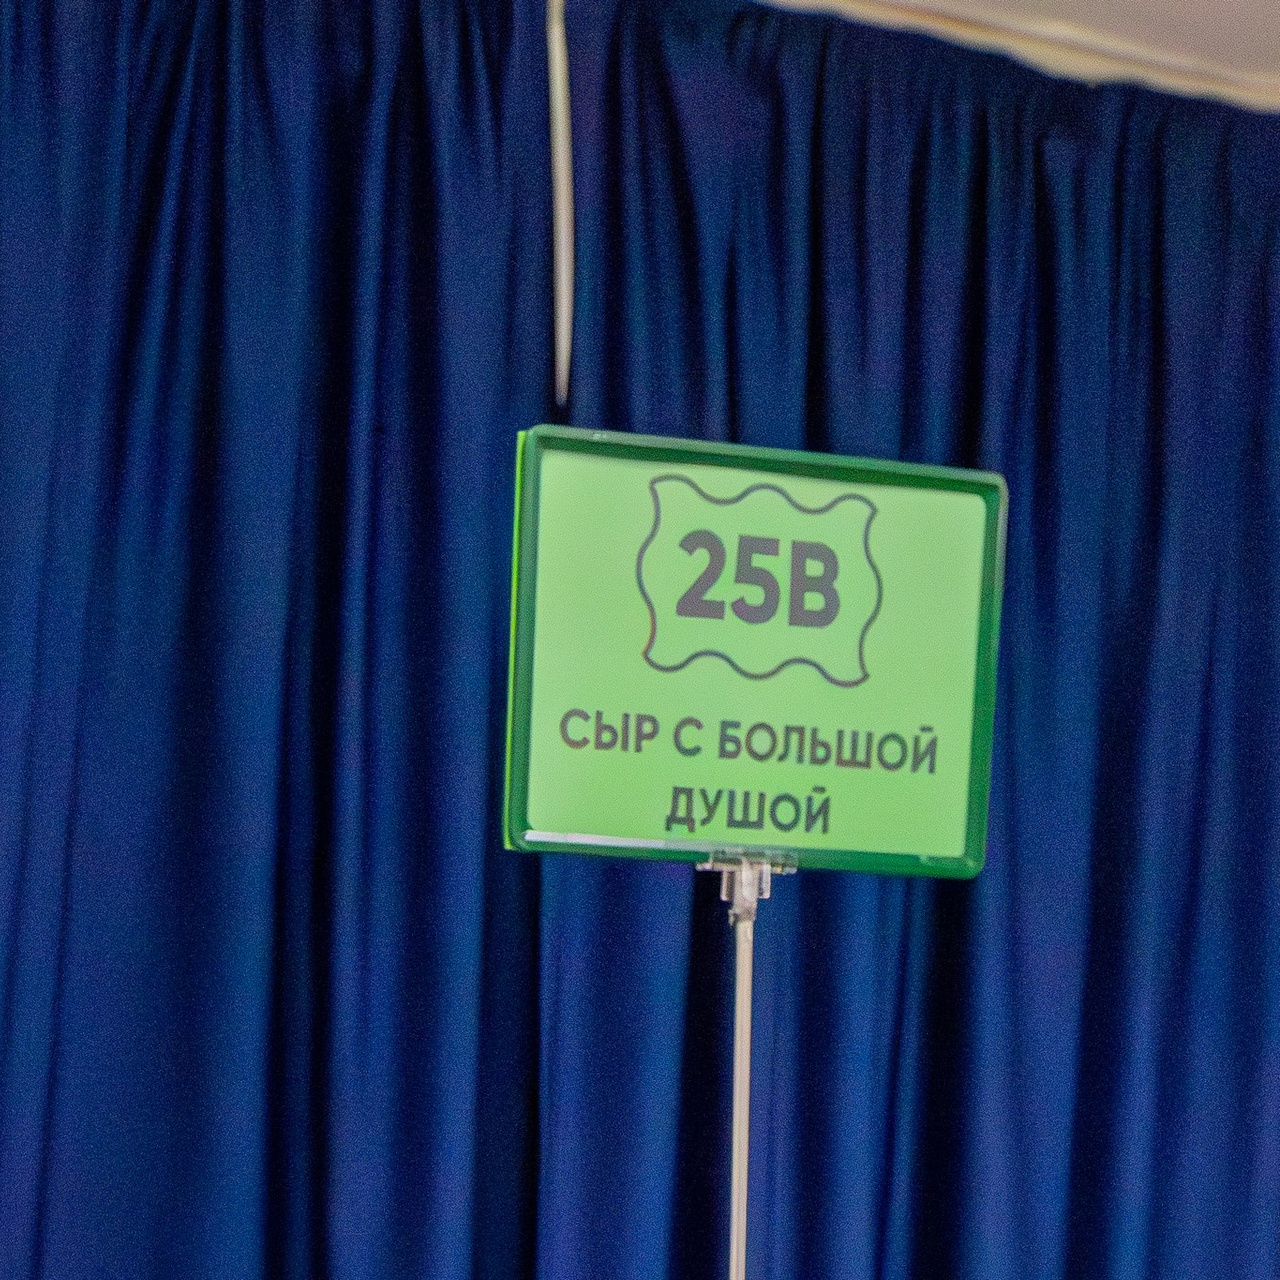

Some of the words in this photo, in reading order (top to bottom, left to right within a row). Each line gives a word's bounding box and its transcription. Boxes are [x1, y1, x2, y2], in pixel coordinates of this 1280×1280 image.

[675, 528, 840, 628] 25В
[559, 708, 659, 753] СЫР
[673, 716, 703, 756] С
[718, 720, 939, 774] БОЛЬШОЙ
[665, 785, 831, 834] ДУШОЙ
